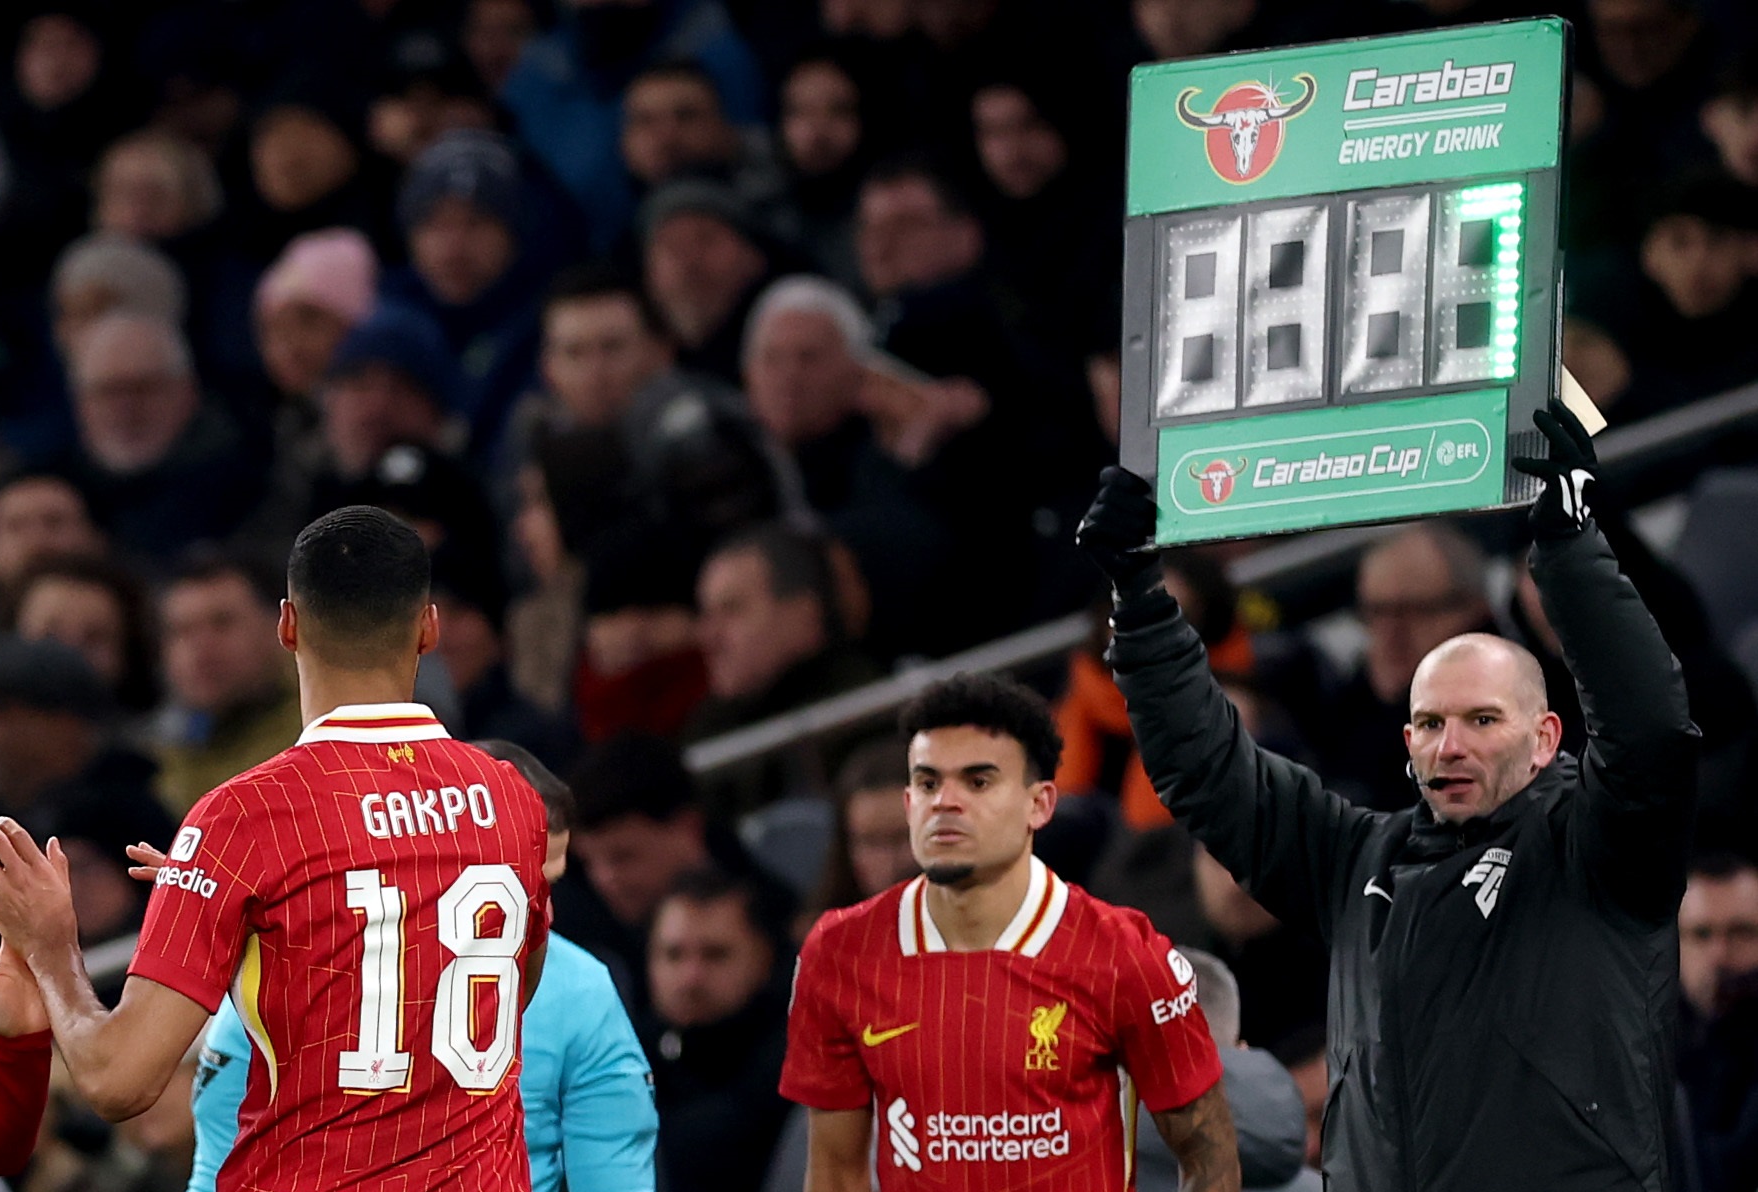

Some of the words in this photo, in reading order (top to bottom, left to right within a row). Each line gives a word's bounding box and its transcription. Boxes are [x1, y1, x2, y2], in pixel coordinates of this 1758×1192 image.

[1343, 58, 1516, 112] Carabao
[1338, 131, 1431, 165] ENERGY
[1433, 122, 1504, 155] DRINK
[1252, 451, 1367, 488] Carabao
[1367, 444, 1422, 478] Cup
[1456, 442, 1480, 460] EFL
[361, 783, 498, 840] GAKPO
[338, 864, 530, 1095] 18
[927, 1107, 1061, 1137] standard
[927, 1129, 1070, 1162] chartered
